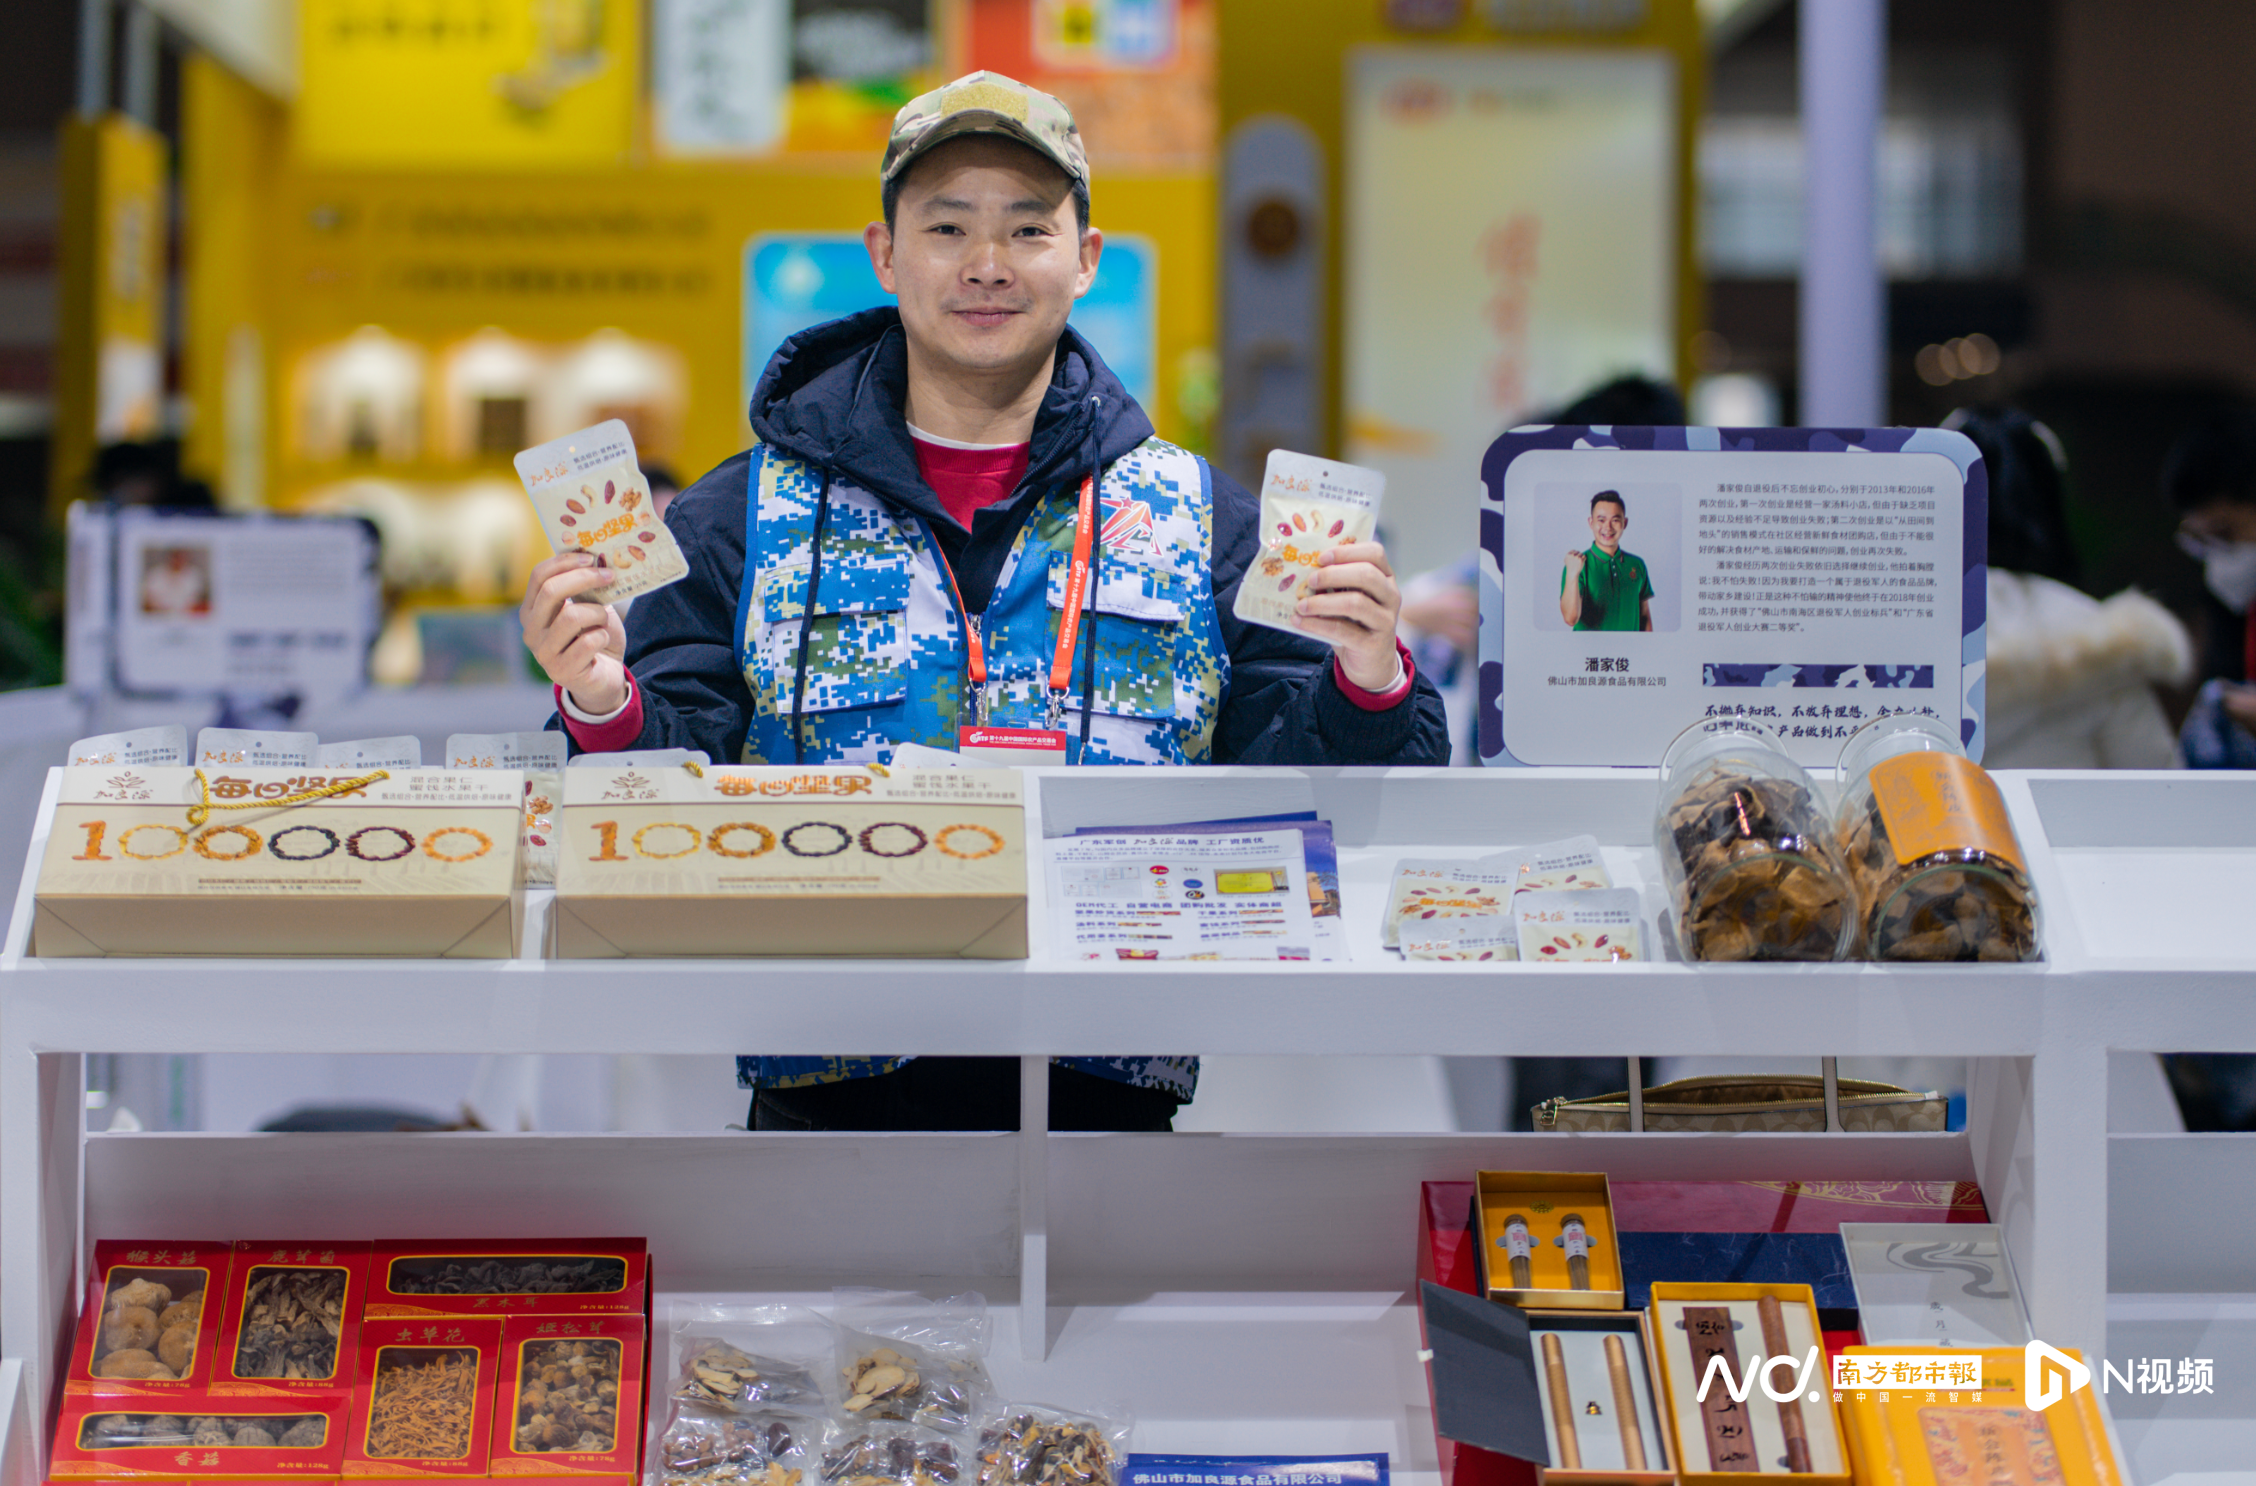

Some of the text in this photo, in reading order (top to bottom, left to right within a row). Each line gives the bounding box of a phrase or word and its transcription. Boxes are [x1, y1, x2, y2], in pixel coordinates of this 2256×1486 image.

[576, 512, 638, 547] 每日坚果
[1585, 657, 1630, 673] 潘家俊
[1547, 675, 1667, 687] 佛山市加良源食品有限公司
[714, 774, 873, 797] 每日坚果
[126, 1249, 197, 1265] 猴头菇
[472, 1296, 539, 1308] 黑木耳
[395, 1326, 465, 1343] 虫草花
[536, 1320, 605, 1335] 姬松茸
[174, 1451, 220, 1466] 香菇
[1132, 1473, 1343, 1486] 佛山市加良源食品有限公司
